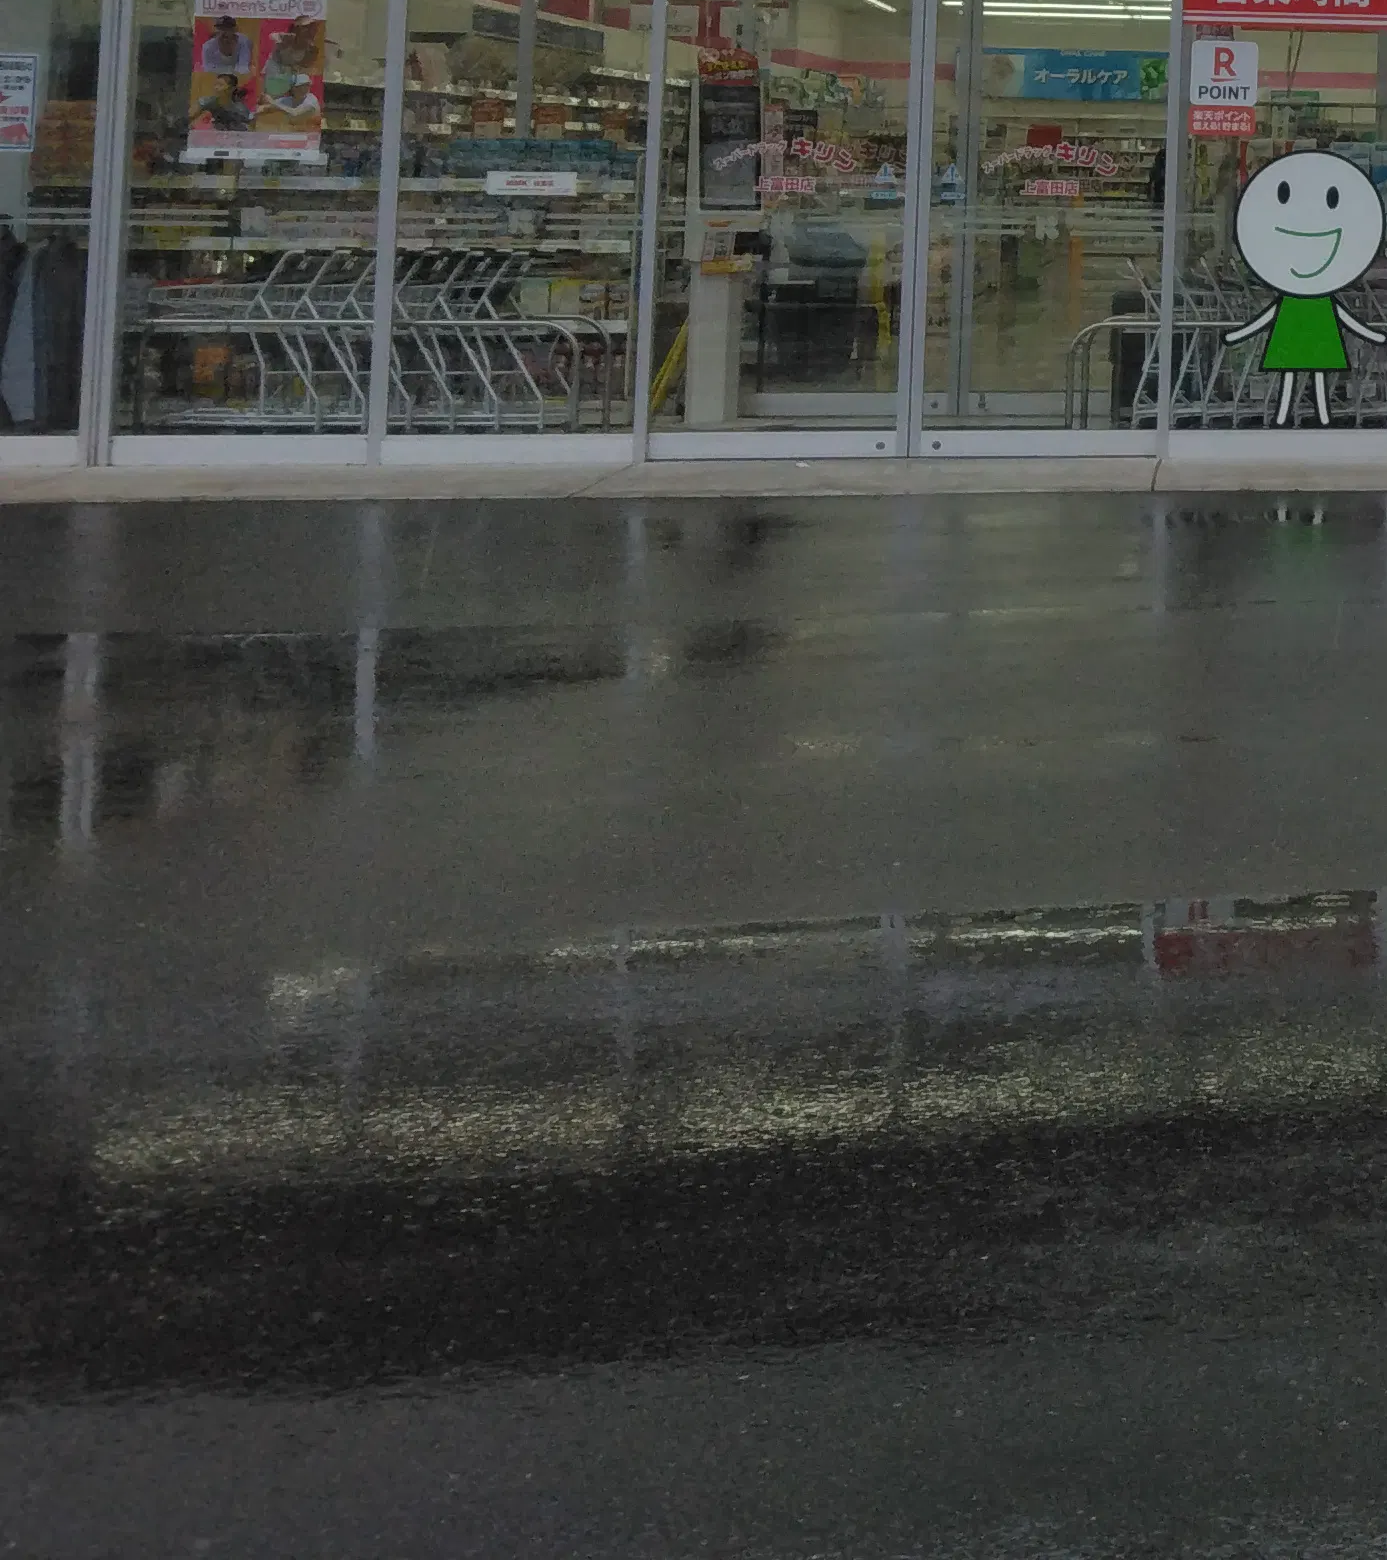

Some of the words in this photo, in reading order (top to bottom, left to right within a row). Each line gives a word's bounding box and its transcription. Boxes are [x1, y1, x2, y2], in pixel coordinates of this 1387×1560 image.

[1214, 47, 1237, 77] R
[1034, 68, 1128, 84] オーラルケア
[1198, 86, 1250, 100] POINT
[791, 138, 856, 172] キリン
[1056, 142, 1118, 176] キリン
[753, 176, 815, 192] 上富田店
[1020, 180, 1079, 196] 上富田店
